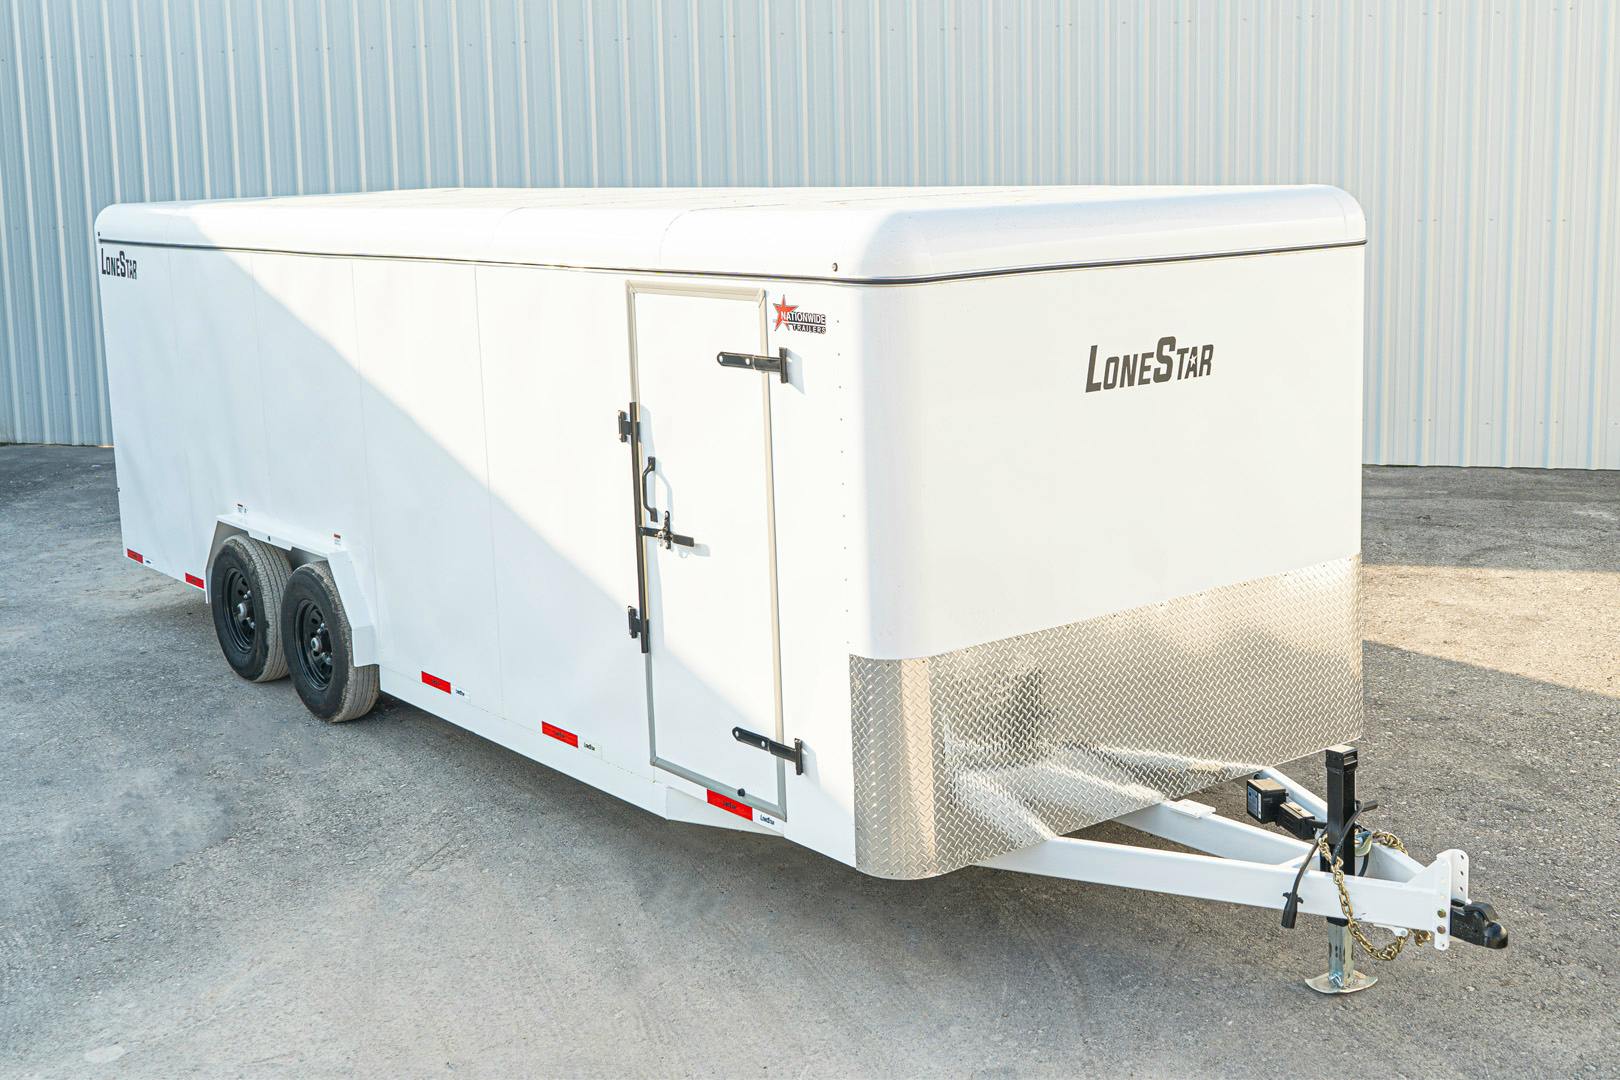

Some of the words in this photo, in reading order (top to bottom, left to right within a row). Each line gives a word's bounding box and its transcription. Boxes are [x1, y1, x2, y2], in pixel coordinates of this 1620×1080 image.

[781, 311, 826, 325] NATIONWIDE
[792, 324, 826, 334] TRAILERS
[1085, 336, 1214, 393] LONESTAR
